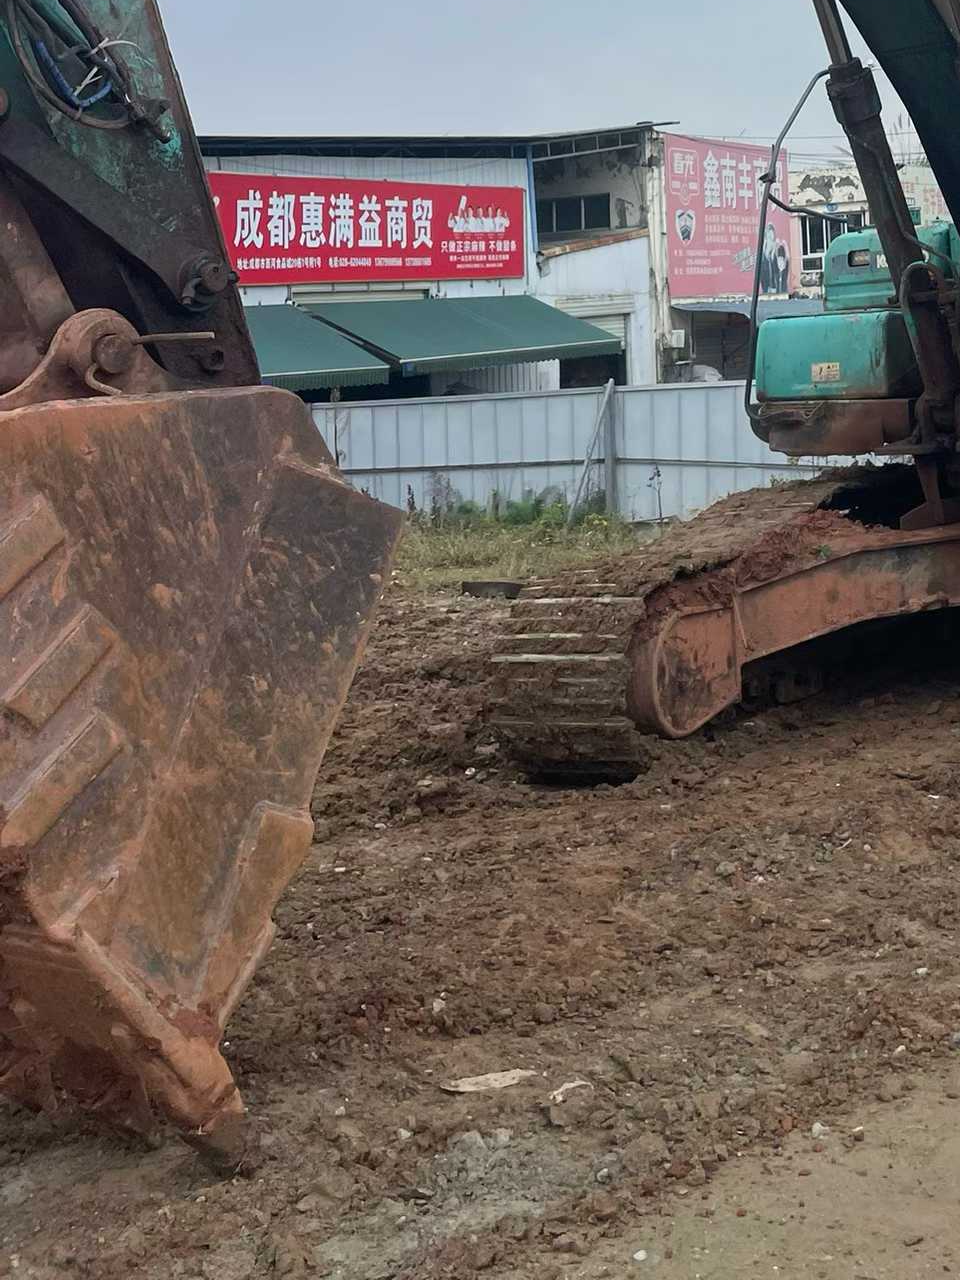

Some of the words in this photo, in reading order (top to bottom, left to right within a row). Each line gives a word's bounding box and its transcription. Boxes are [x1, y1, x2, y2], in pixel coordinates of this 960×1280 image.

[233, 189, 433, 249] 成都惠满益商贸
